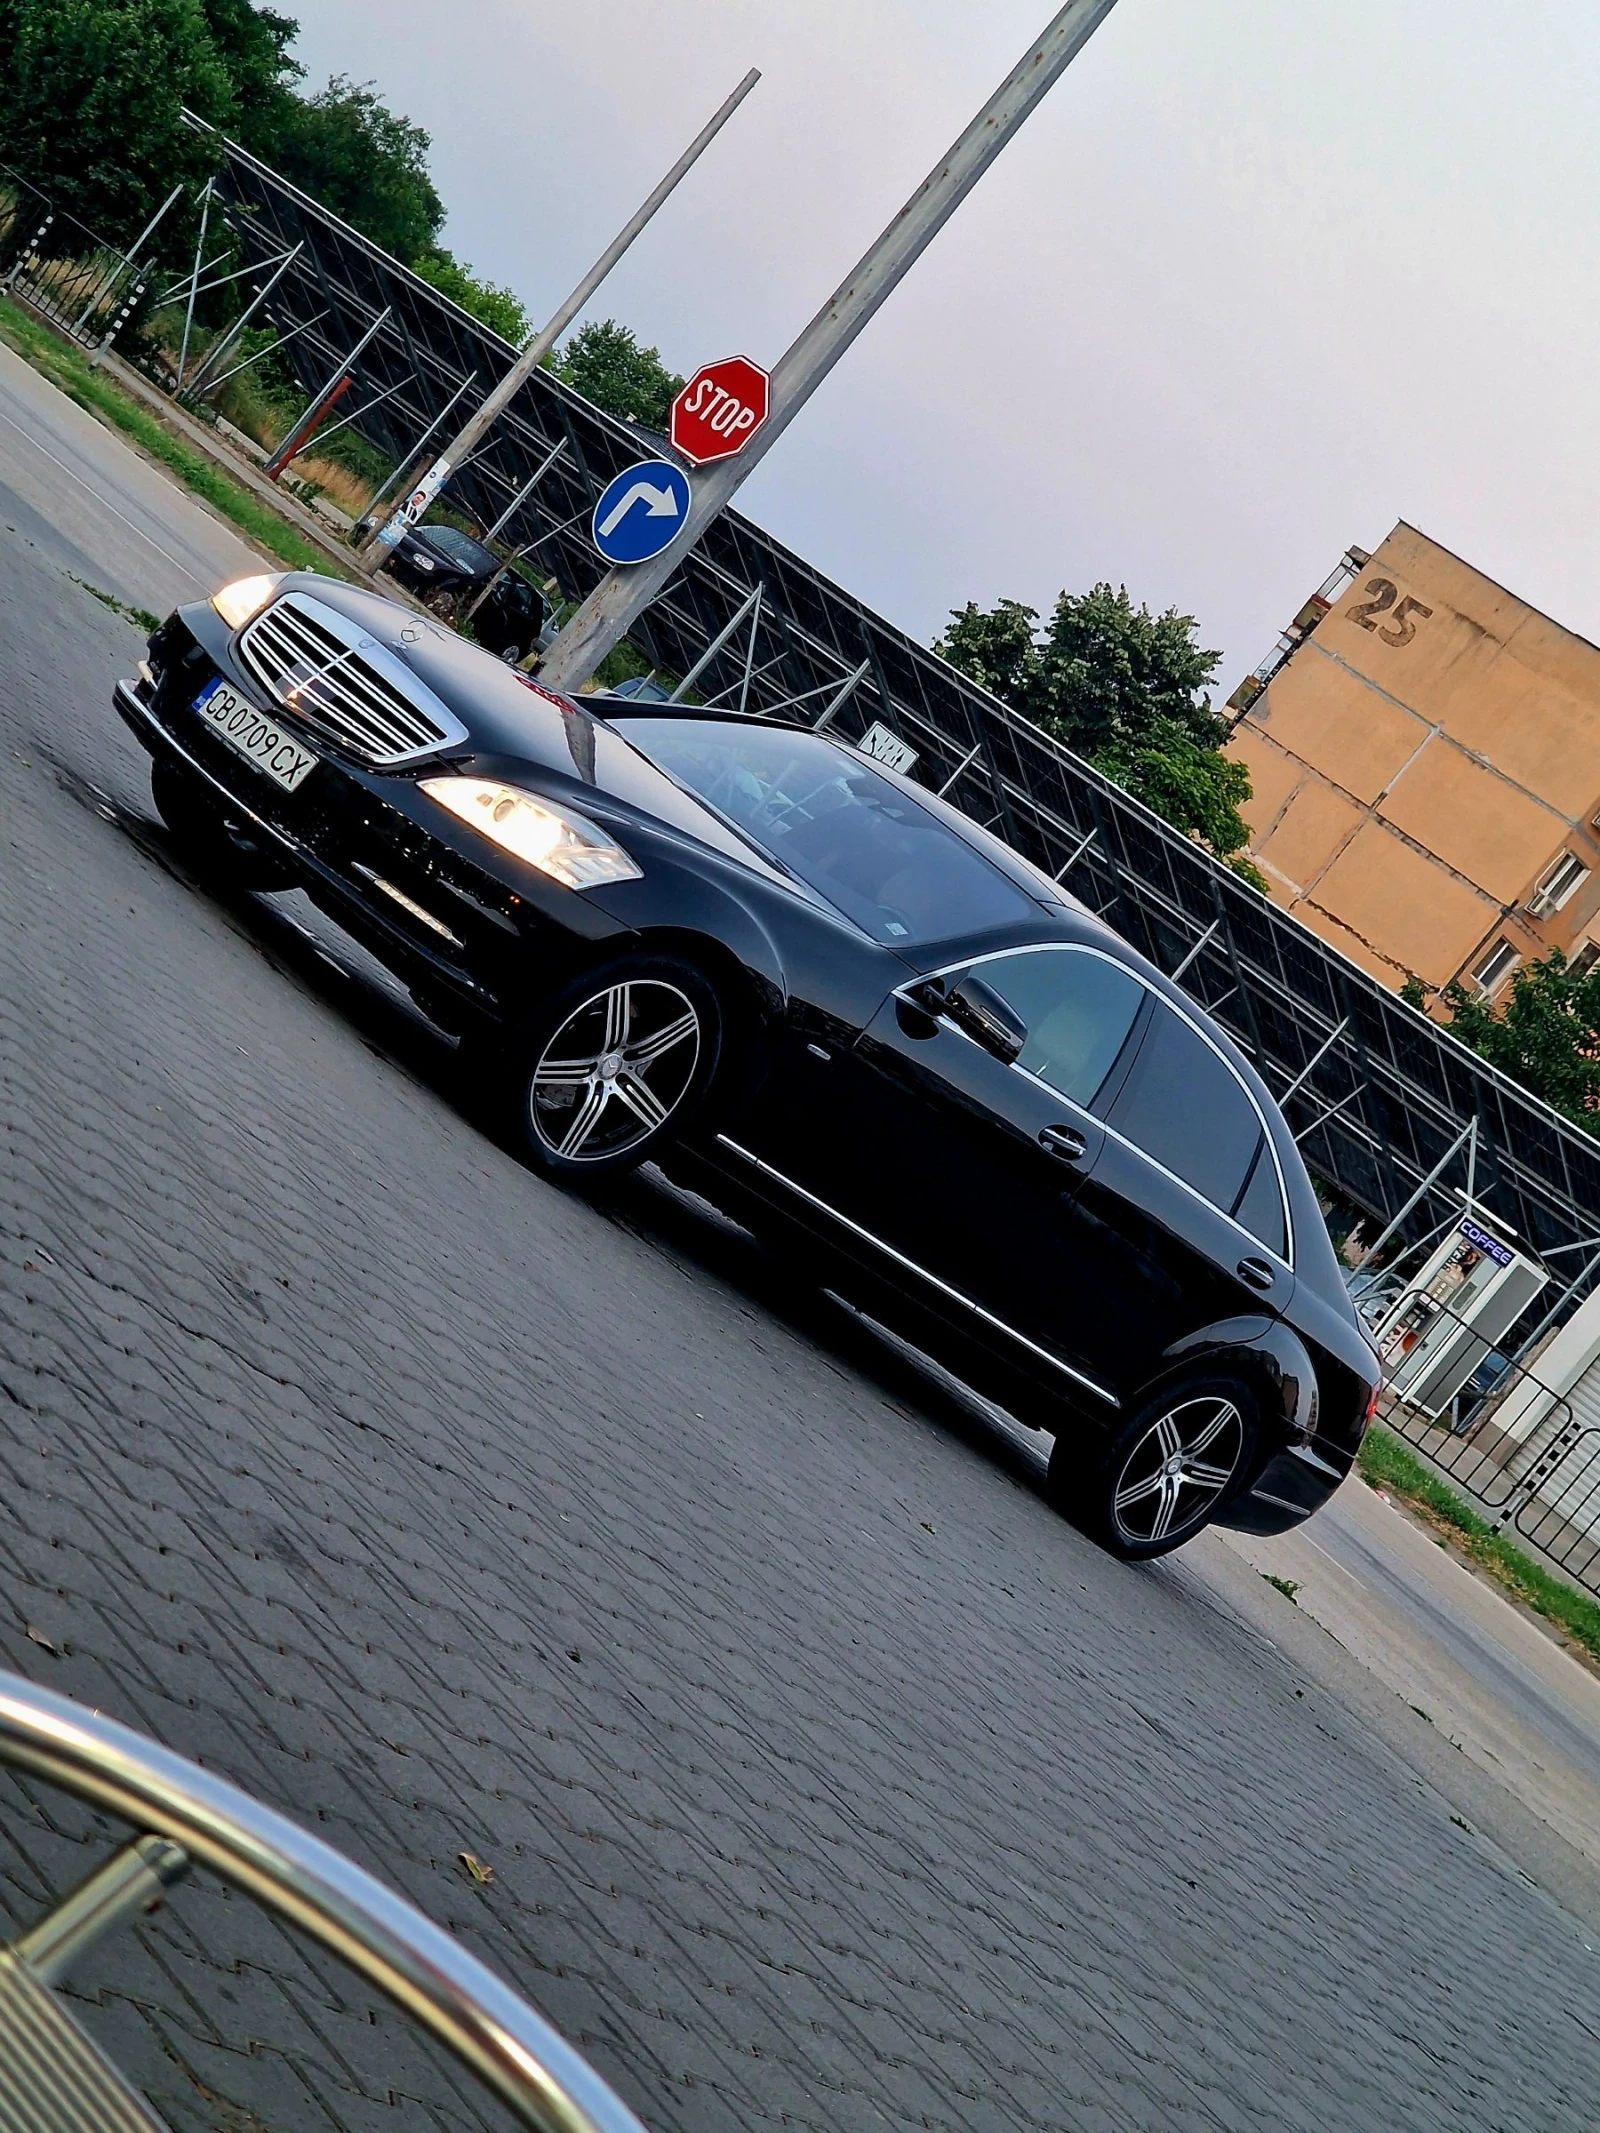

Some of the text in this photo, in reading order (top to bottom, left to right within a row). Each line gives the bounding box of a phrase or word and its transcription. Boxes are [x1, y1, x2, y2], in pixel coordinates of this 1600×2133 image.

[685, 379, 755, 438] STOP
[1345, 578, 1433, 647] 25
[1460, 1221, 1512, 1264] COFFEE
